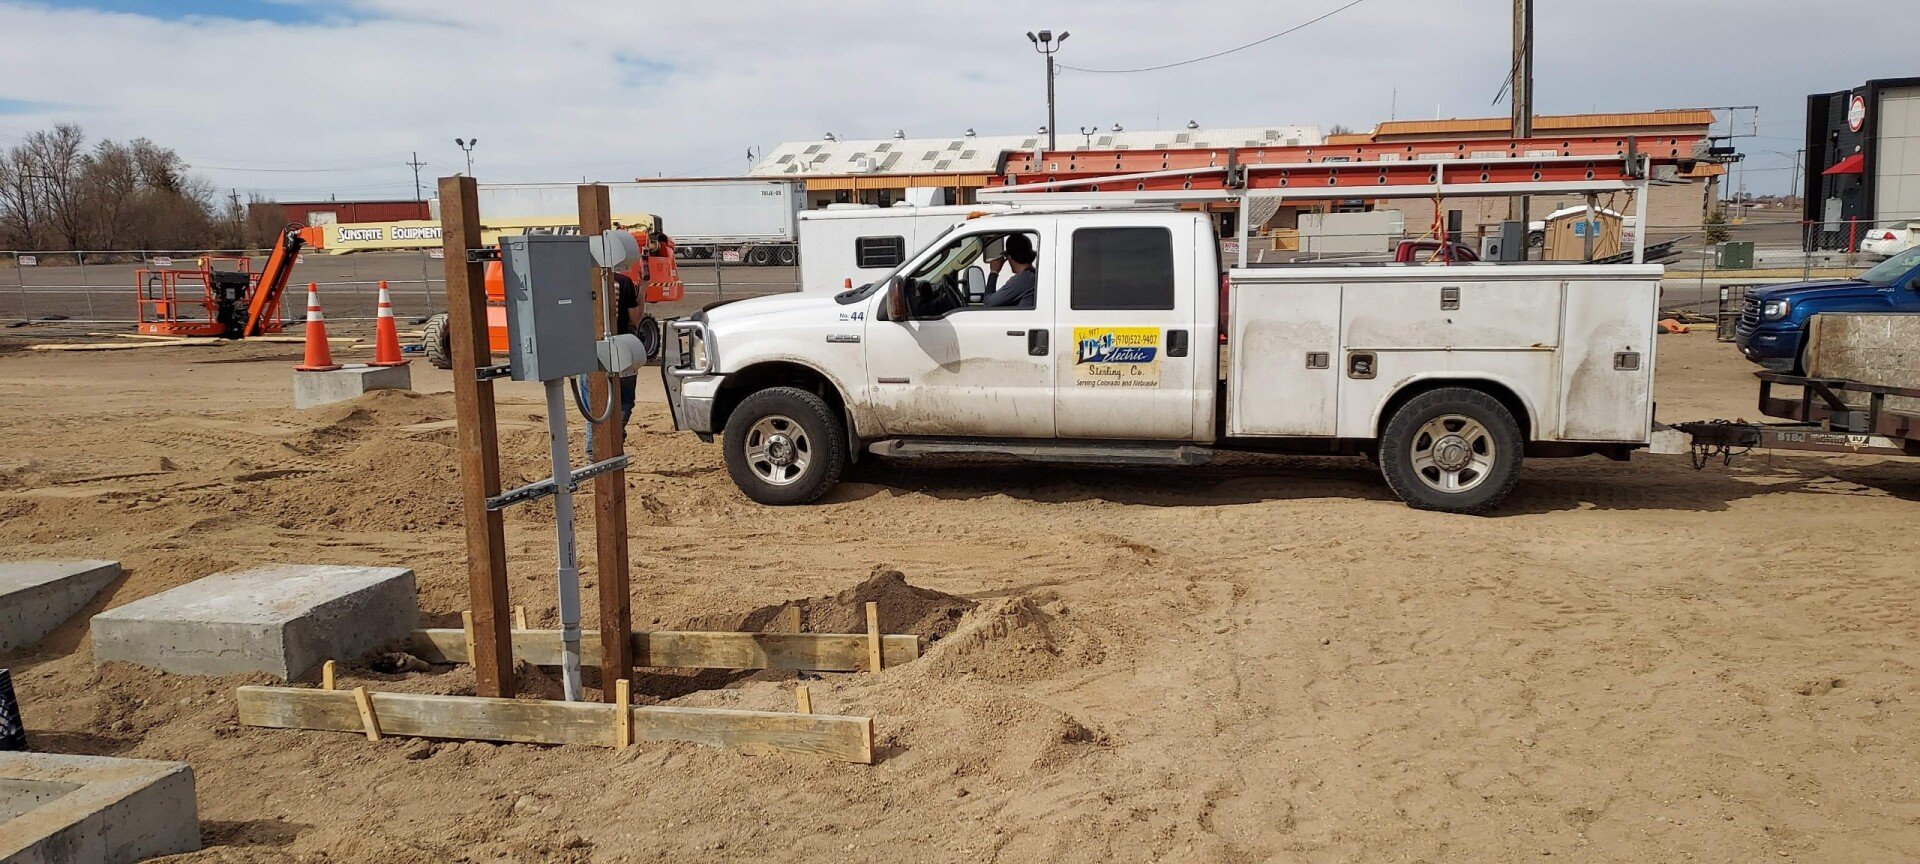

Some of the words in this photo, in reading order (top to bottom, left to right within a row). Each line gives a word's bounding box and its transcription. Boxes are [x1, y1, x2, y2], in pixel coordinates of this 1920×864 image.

[338, 227, 382, 243] SUNSTATE
[391, 226, 442, 240] EQUIPMENT
[851, 311, 864, 321] 44
[1116, 335, 1157, 346] (970)522-9407
[1102, 347, 1148, 362] Electric
[1089, 365, 1125, 380] Sterling,
[1131, 365, 1145, 376] Co.
[1076, 380, 1096, 388] Serving
